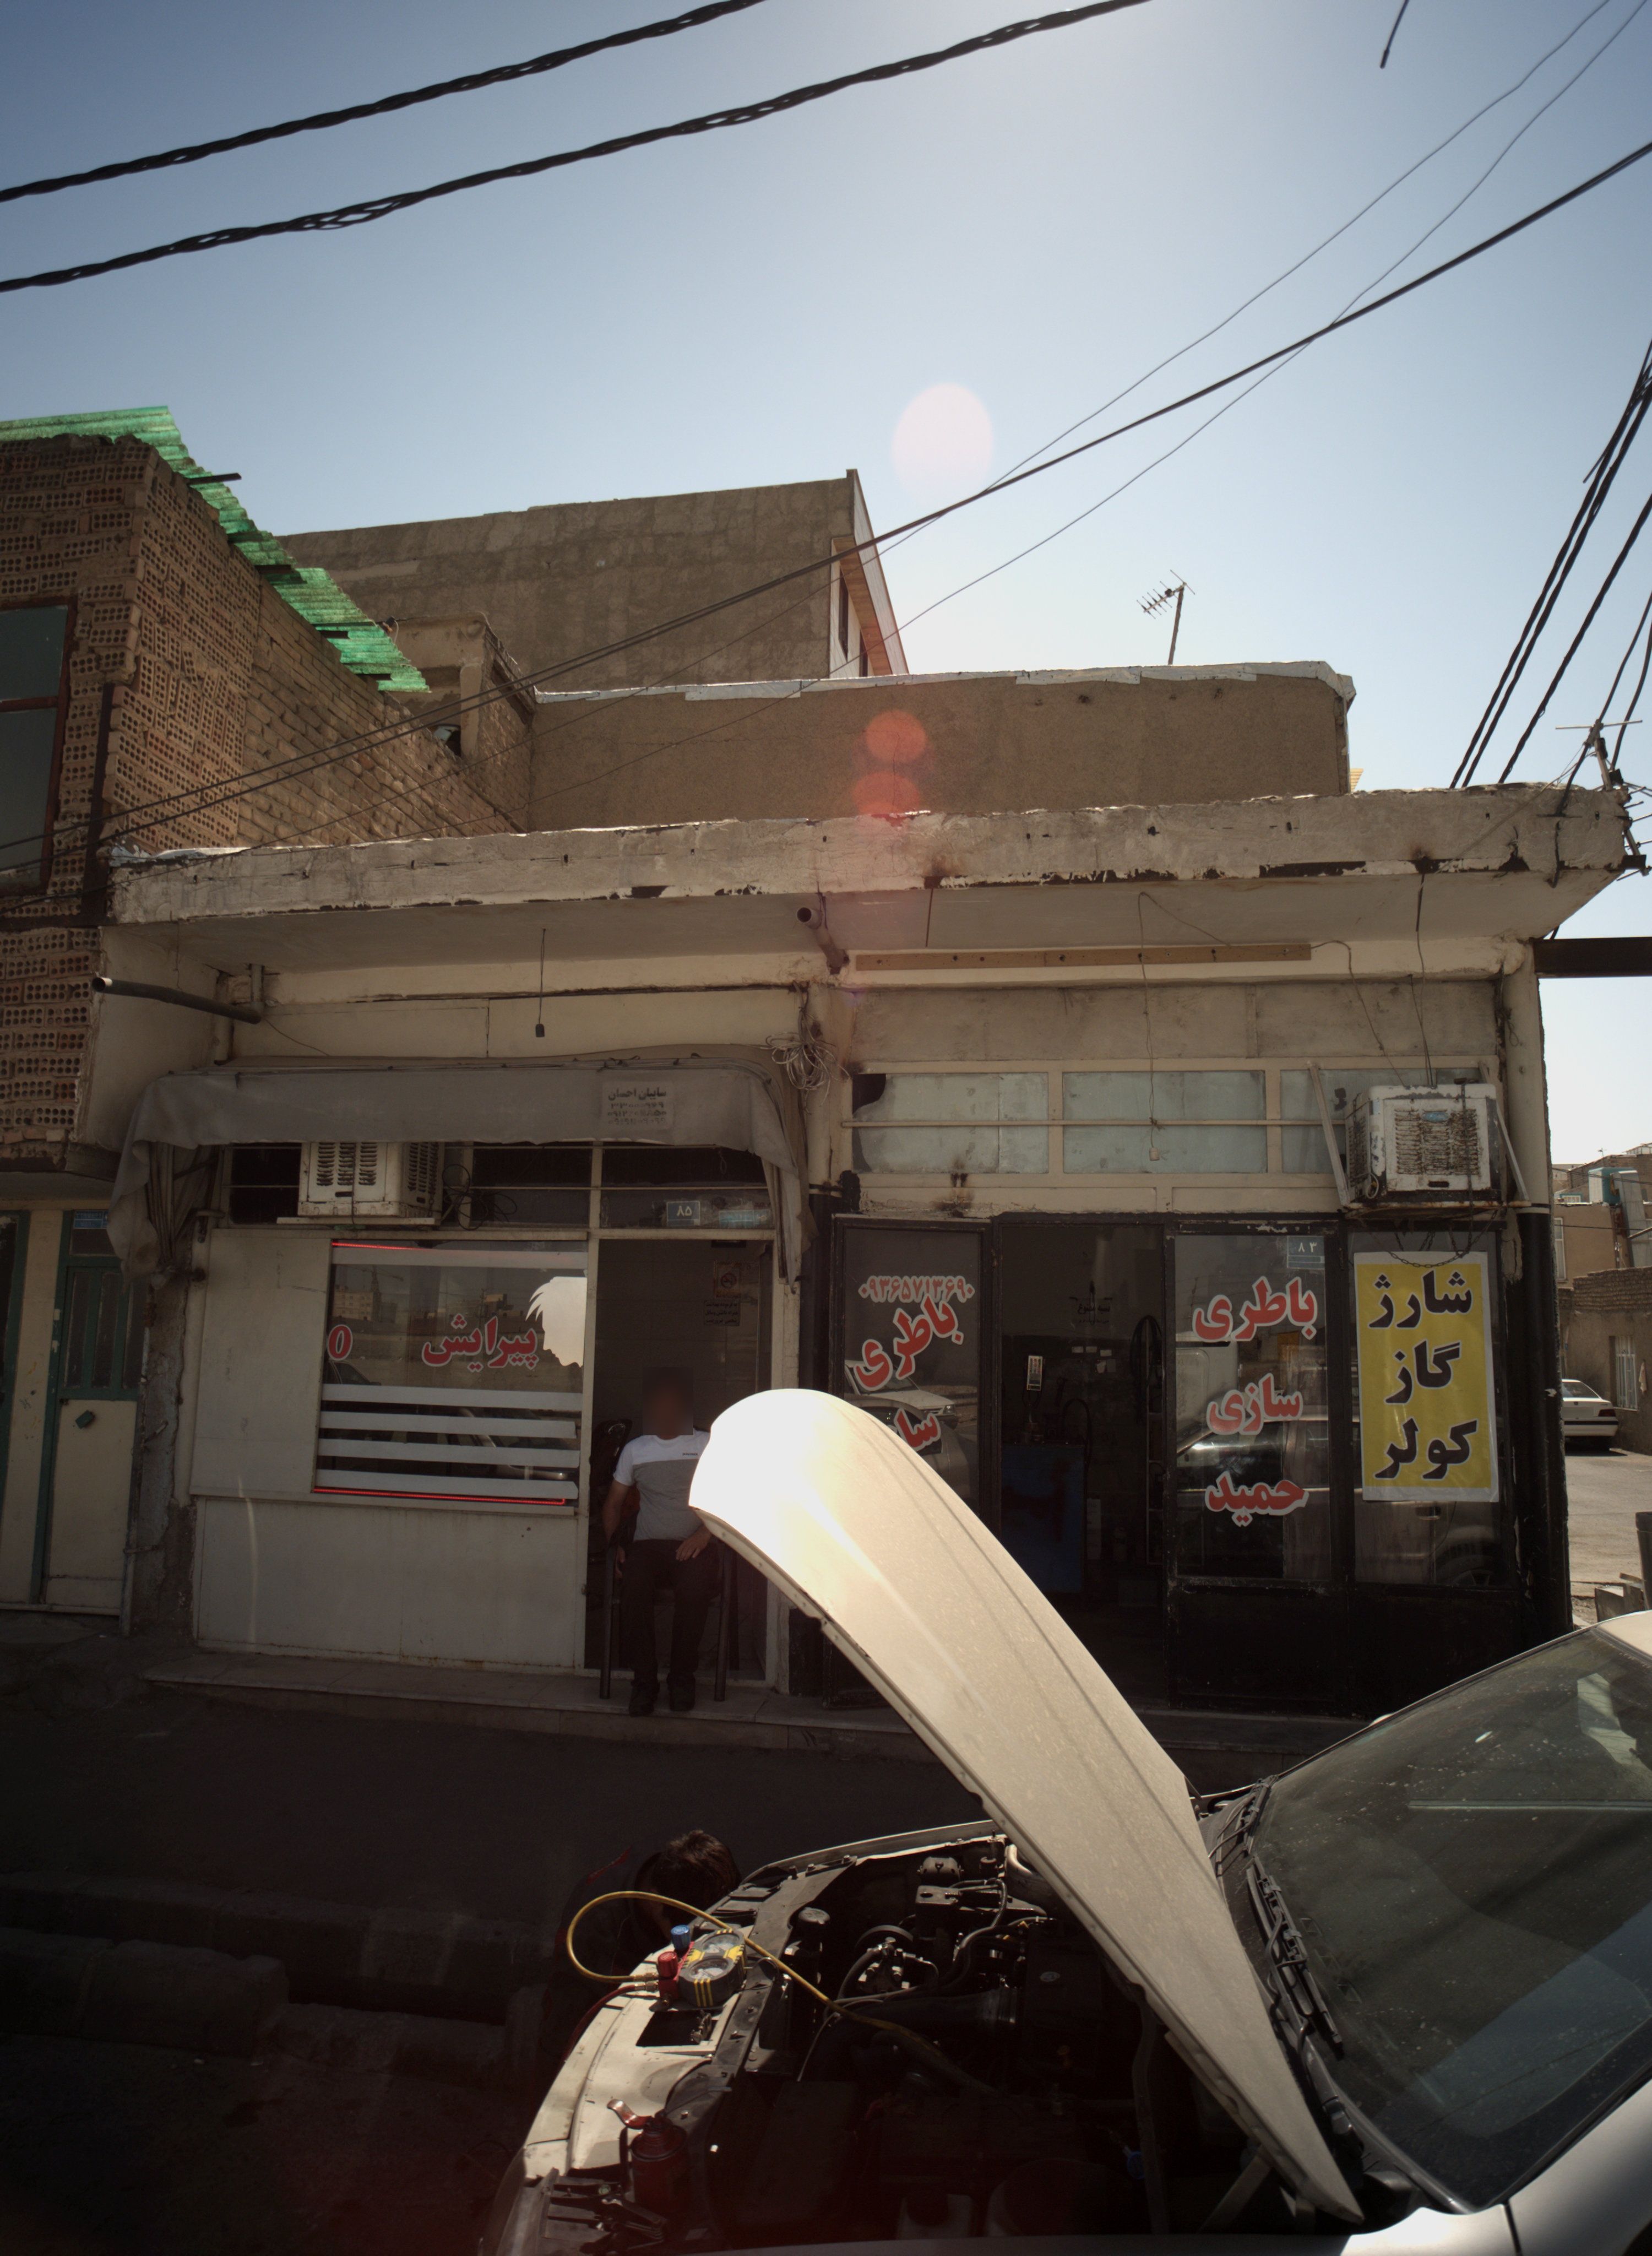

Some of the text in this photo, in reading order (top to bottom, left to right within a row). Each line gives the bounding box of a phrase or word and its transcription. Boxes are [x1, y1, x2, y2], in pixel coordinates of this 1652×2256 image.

[676, 1205, 693, 1217] ۸۵
[1298, 1241, 1317, 1253] ۸۳
[1193, 1276, 1317, 1341] باطری
[1368, 1269, 1472, 1328] شارژ
[422, 1314, 539, 1373] پیرایش
[854, 1294, 964, 1391] باطری
[1384, 1340, 1461, 1404] گاز
[1207, 1373, 1303, 1435] سازی
[1374, 1417, 1478, 1479] کولر
[1205, 1470, 1309, 1527] حمید
